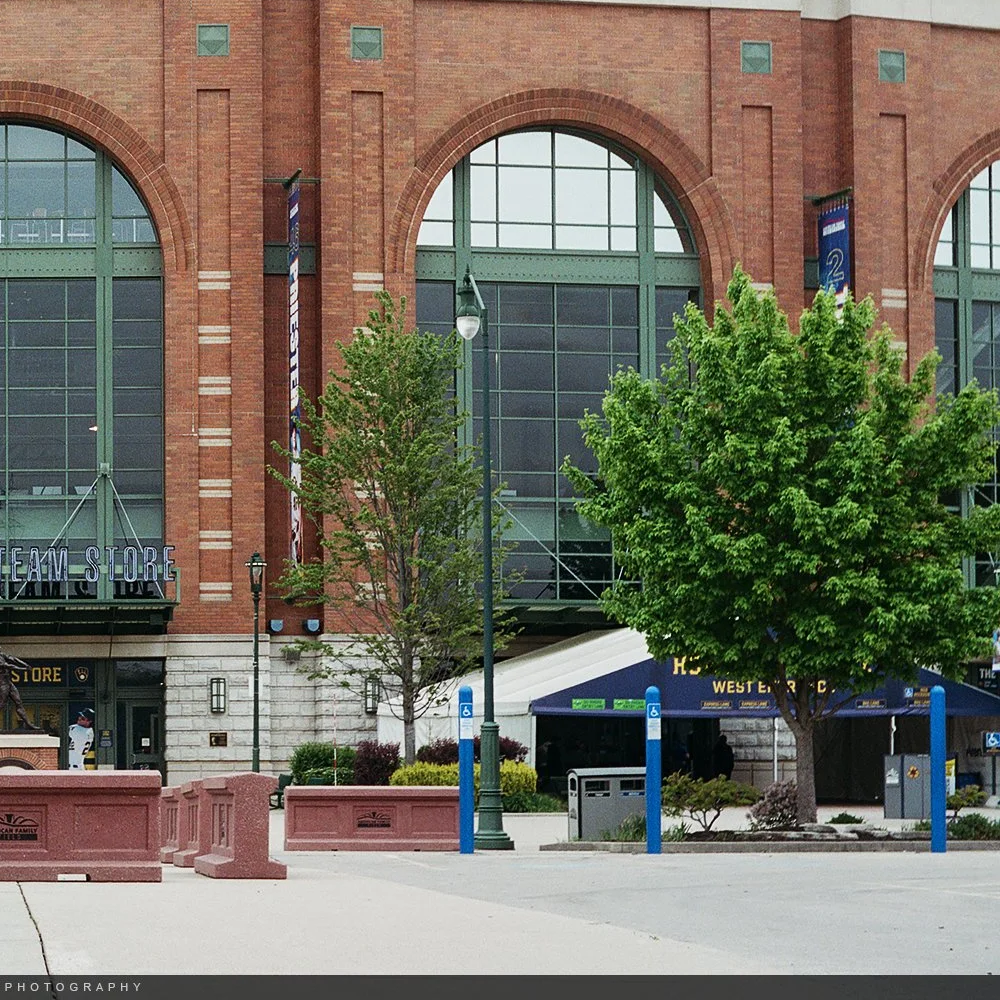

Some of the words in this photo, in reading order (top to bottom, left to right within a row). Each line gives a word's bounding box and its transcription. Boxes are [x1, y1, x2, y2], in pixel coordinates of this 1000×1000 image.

[826, 248, 844, 284] 2
[289, 258, 299, 411] PRIESTER
[85, 546, 176, 583] STORE
[11, 666, 62, 683] STORE
[712, 680, 752, 694] WEST
